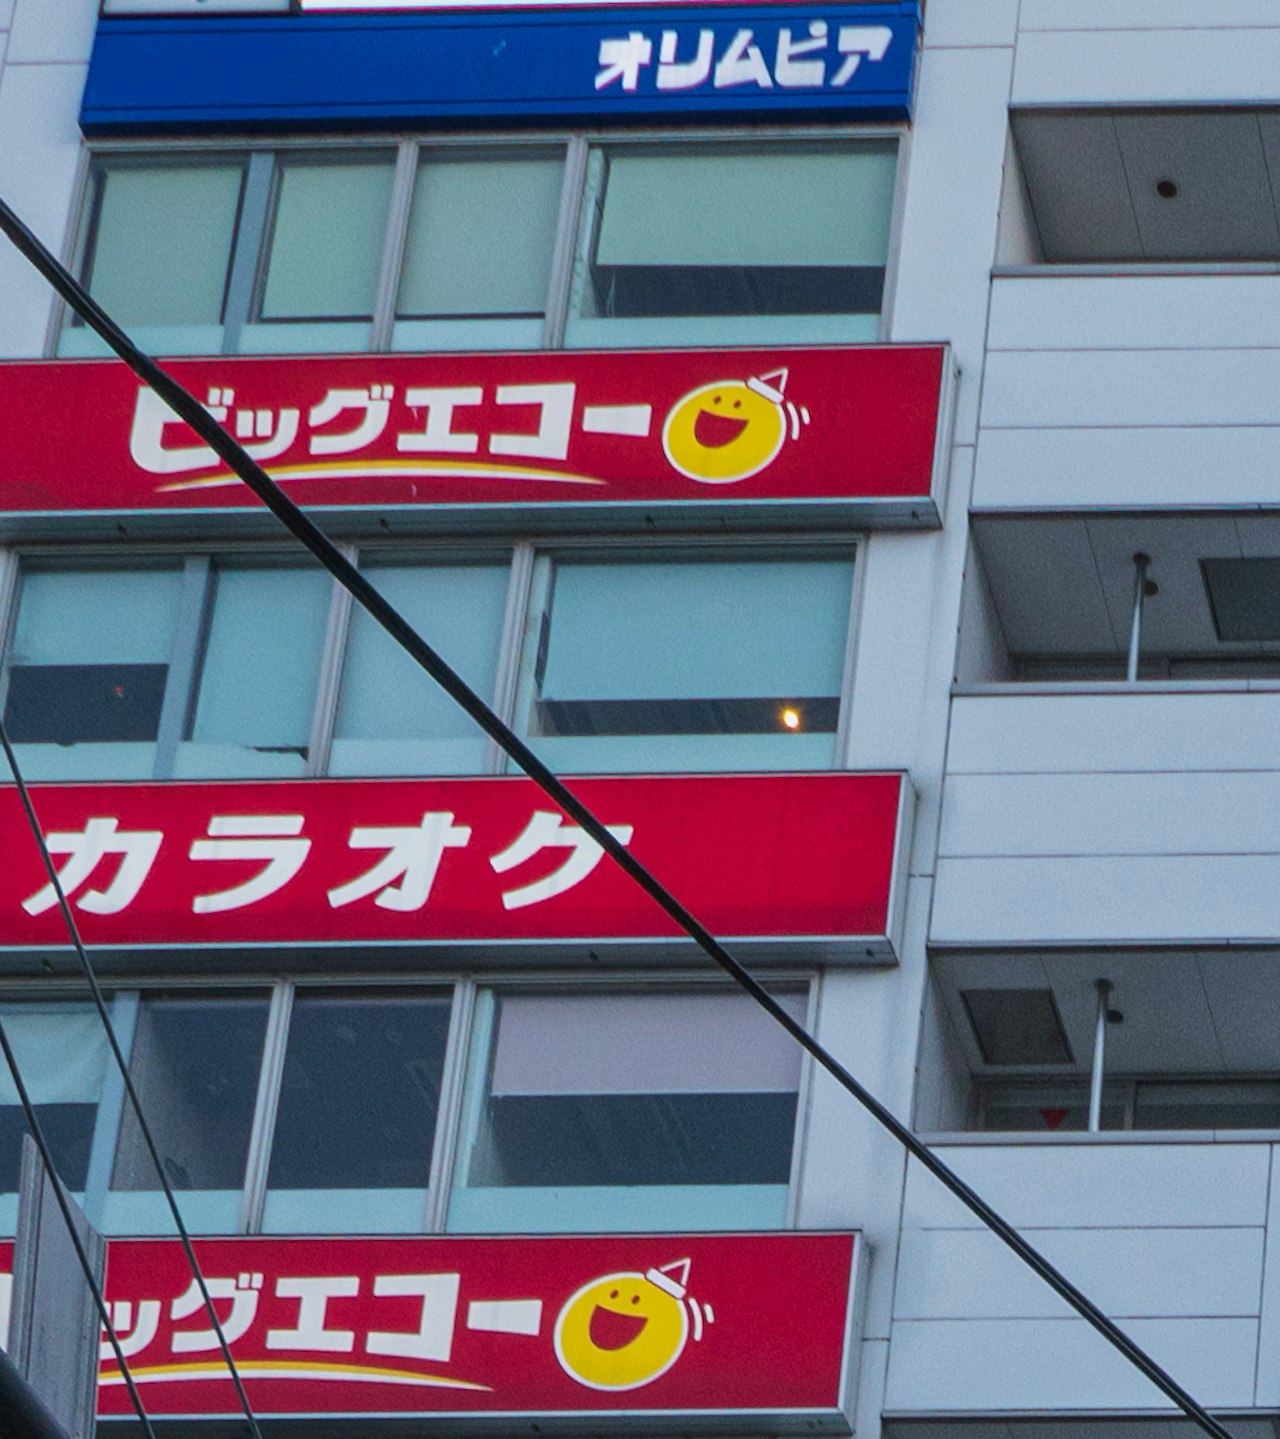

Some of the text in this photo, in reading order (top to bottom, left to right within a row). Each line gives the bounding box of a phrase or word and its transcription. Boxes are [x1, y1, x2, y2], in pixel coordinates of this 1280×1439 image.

[595, 20, 893, 91] オリムピア
[129, 382, 653, 474] ビッグエコー
[22, 811, 633, 916] カラオケ
